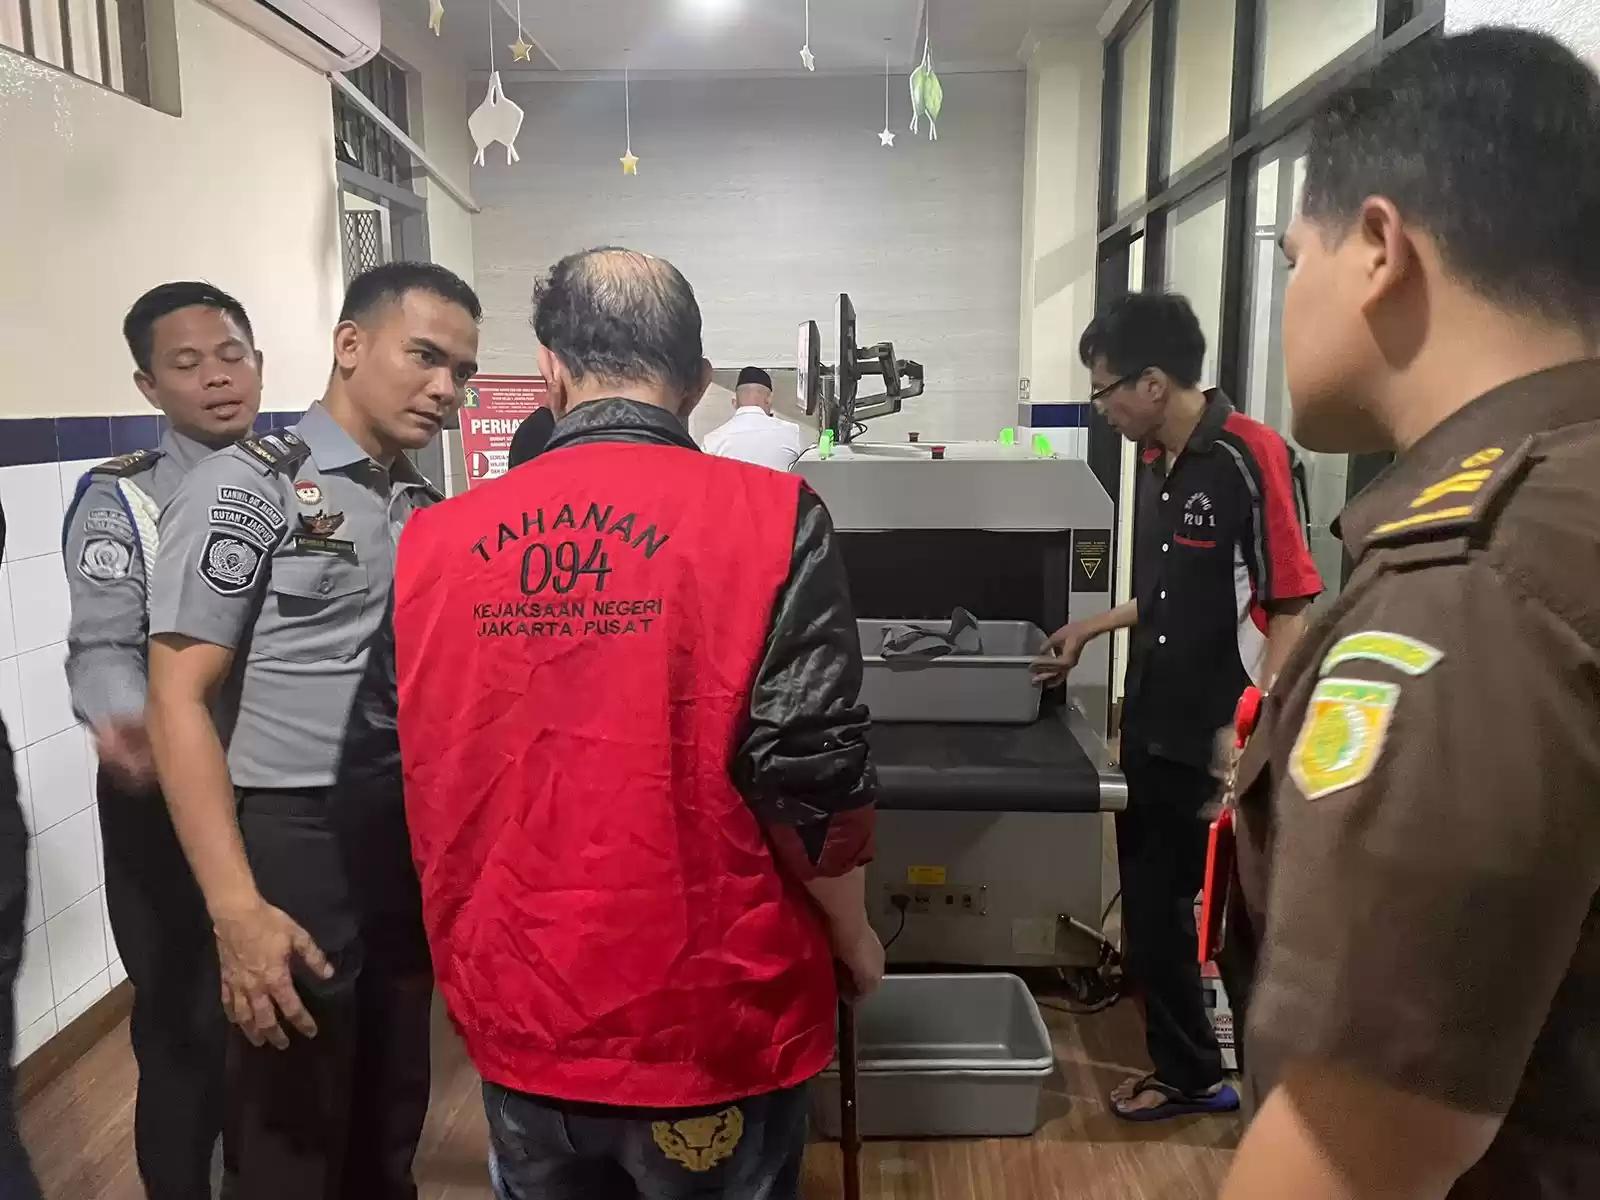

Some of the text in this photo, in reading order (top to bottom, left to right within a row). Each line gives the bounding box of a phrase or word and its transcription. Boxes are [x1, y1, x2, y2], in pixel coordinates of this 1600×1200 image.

[213, 510, 242, 523] RUTAN
[247, 519, 273, 542] JAKPUS
[471, 502, 671, 561] TAHANAN
[1208, 514, 1217, 527] 1
[520, 539, 612, 596] 094
[472, 598, 662, 620] KEJAKSAAN NEGERI
[476, 618, 654, 637] JAKARTA PUSAT
